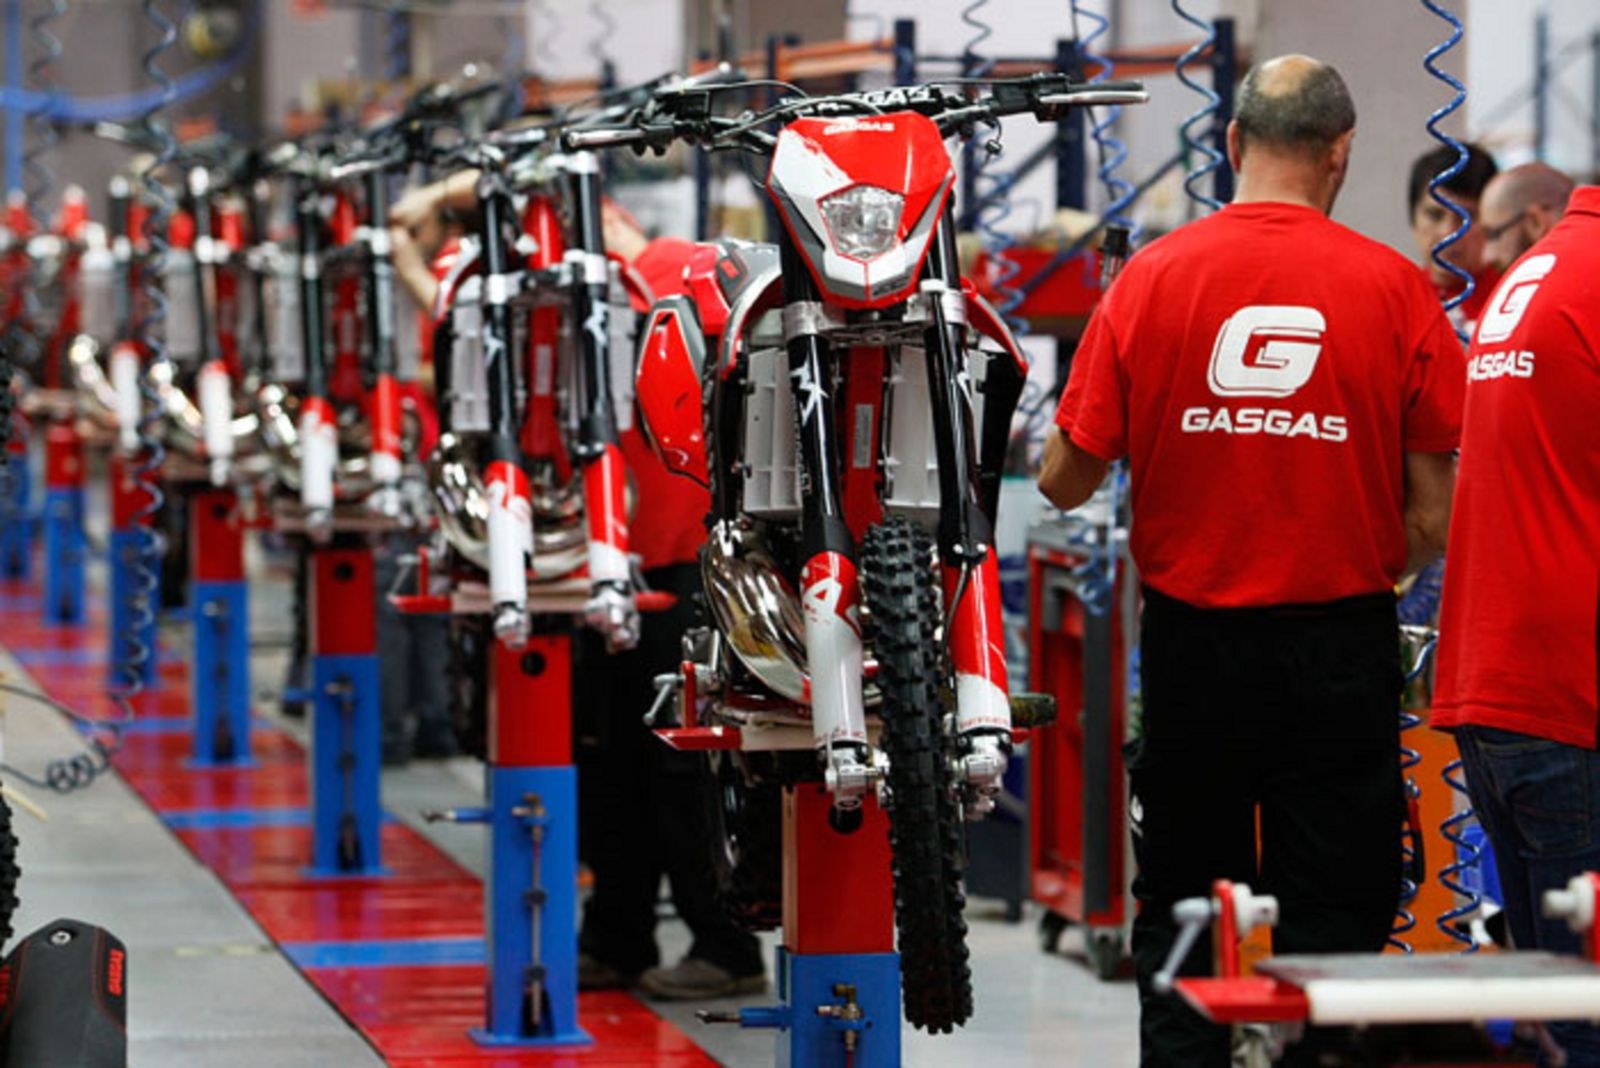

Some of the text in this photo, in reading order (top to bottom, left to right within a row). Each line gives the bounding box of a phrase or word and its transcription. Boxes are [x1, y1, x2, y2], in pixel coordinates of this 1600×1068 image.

[1206, 305, 1327, 398] G
[1467, 350, 1535, 384] ASGAS
[1181, 406, 1349, 443] GASGAS
